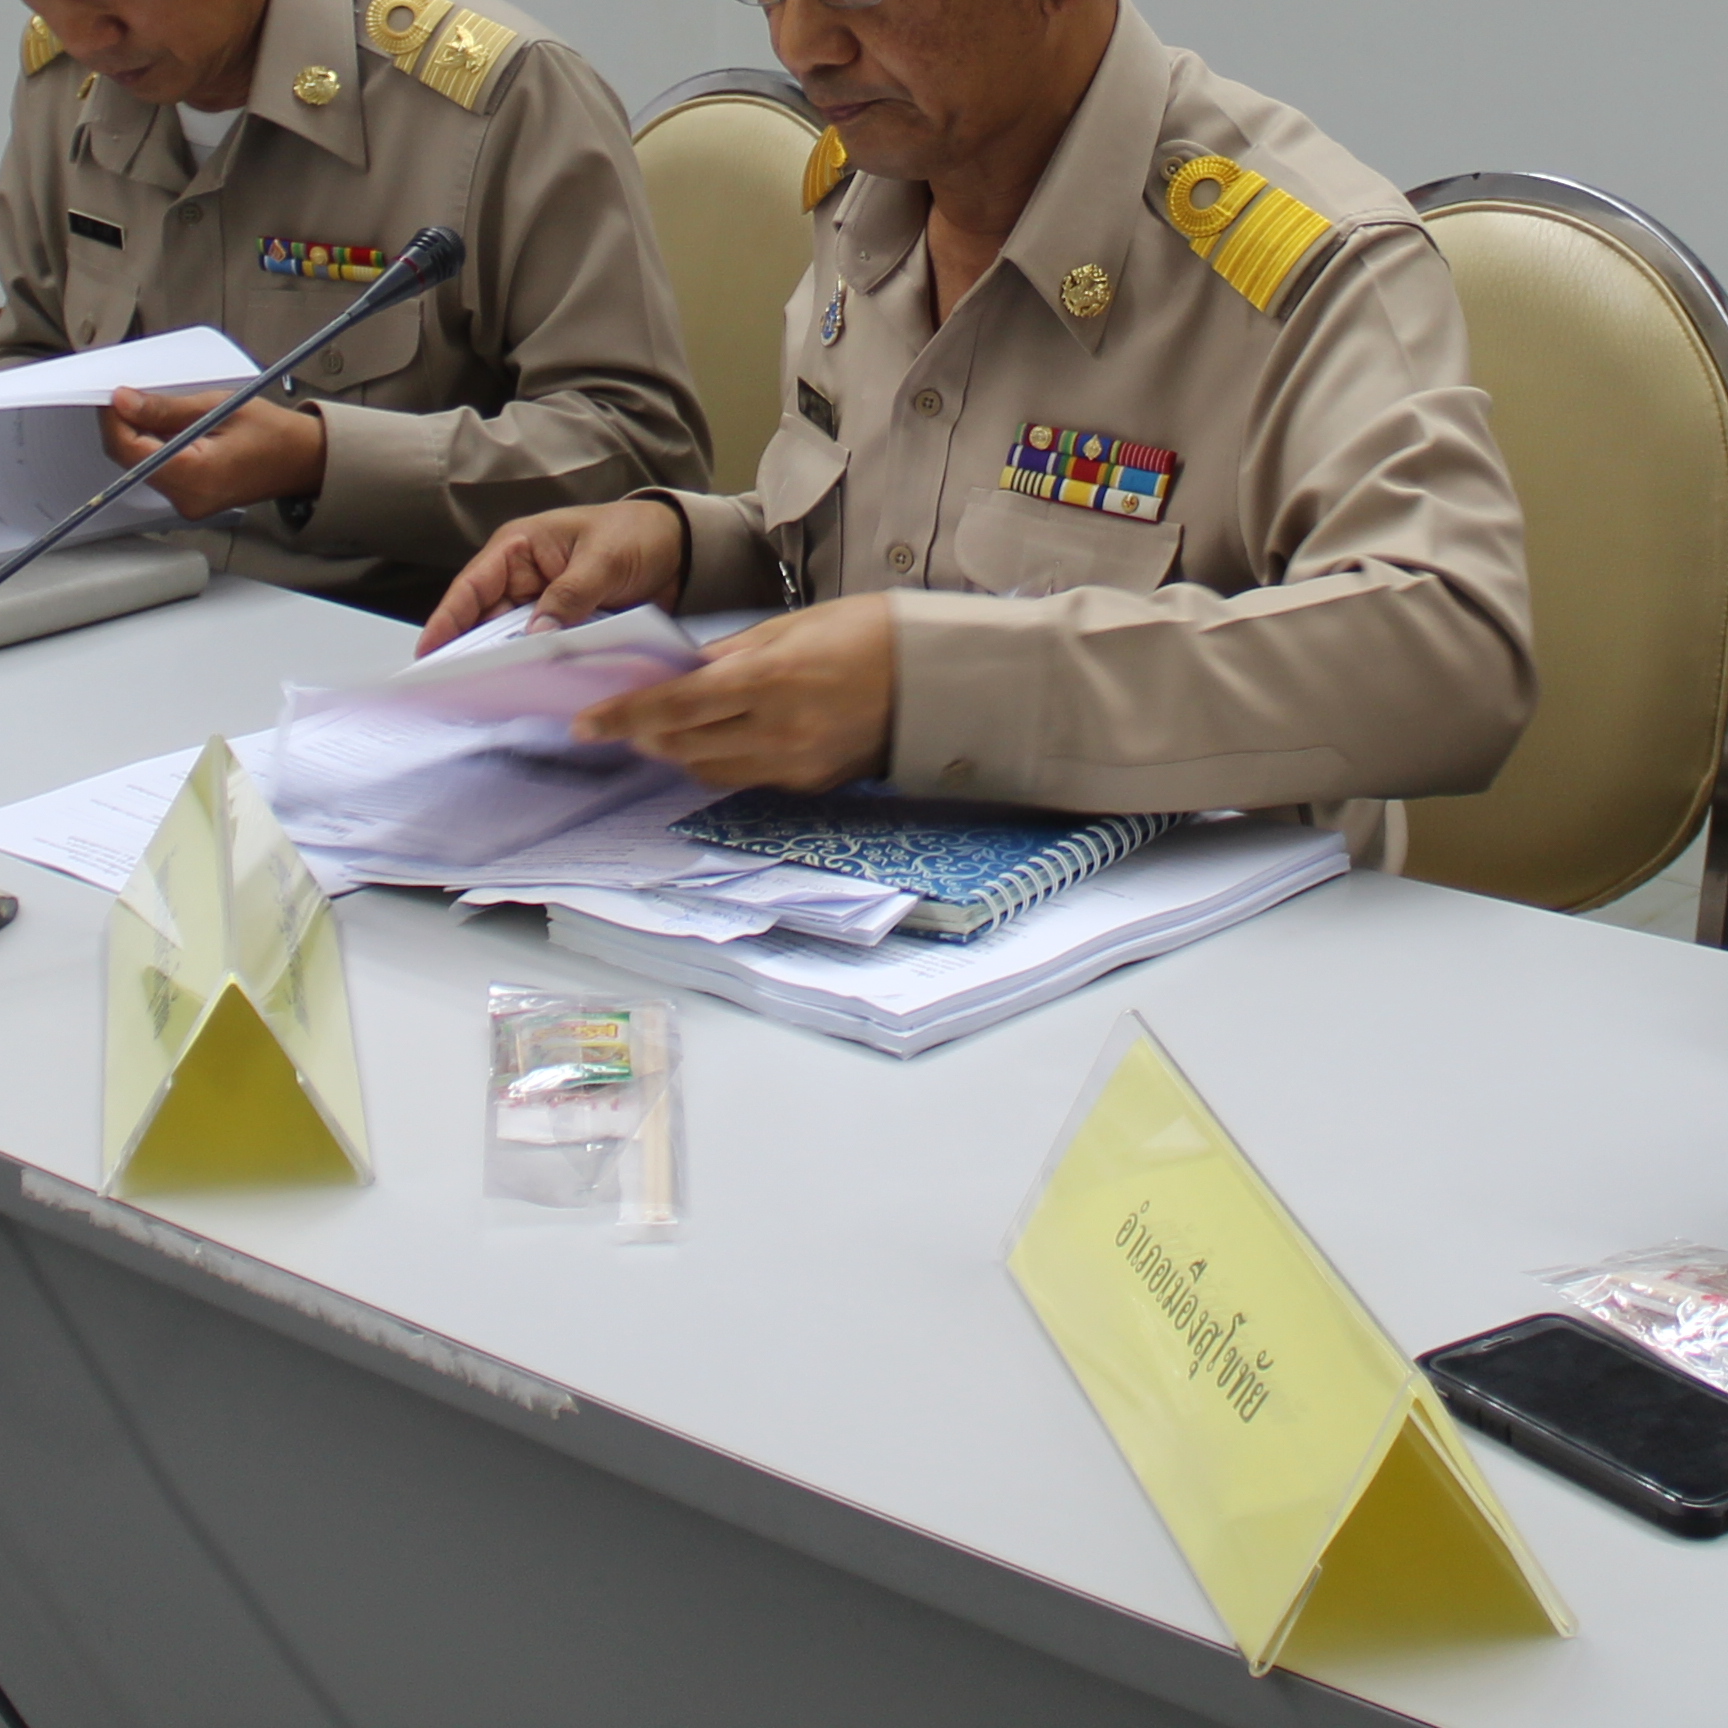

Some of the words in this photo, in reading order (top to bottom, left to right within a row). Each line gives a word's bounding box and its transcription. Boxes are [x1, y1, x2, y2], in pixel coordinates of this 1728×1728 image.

[1115, 1200, 1274, 1423] อำเภอเมืองสุโขทัย
